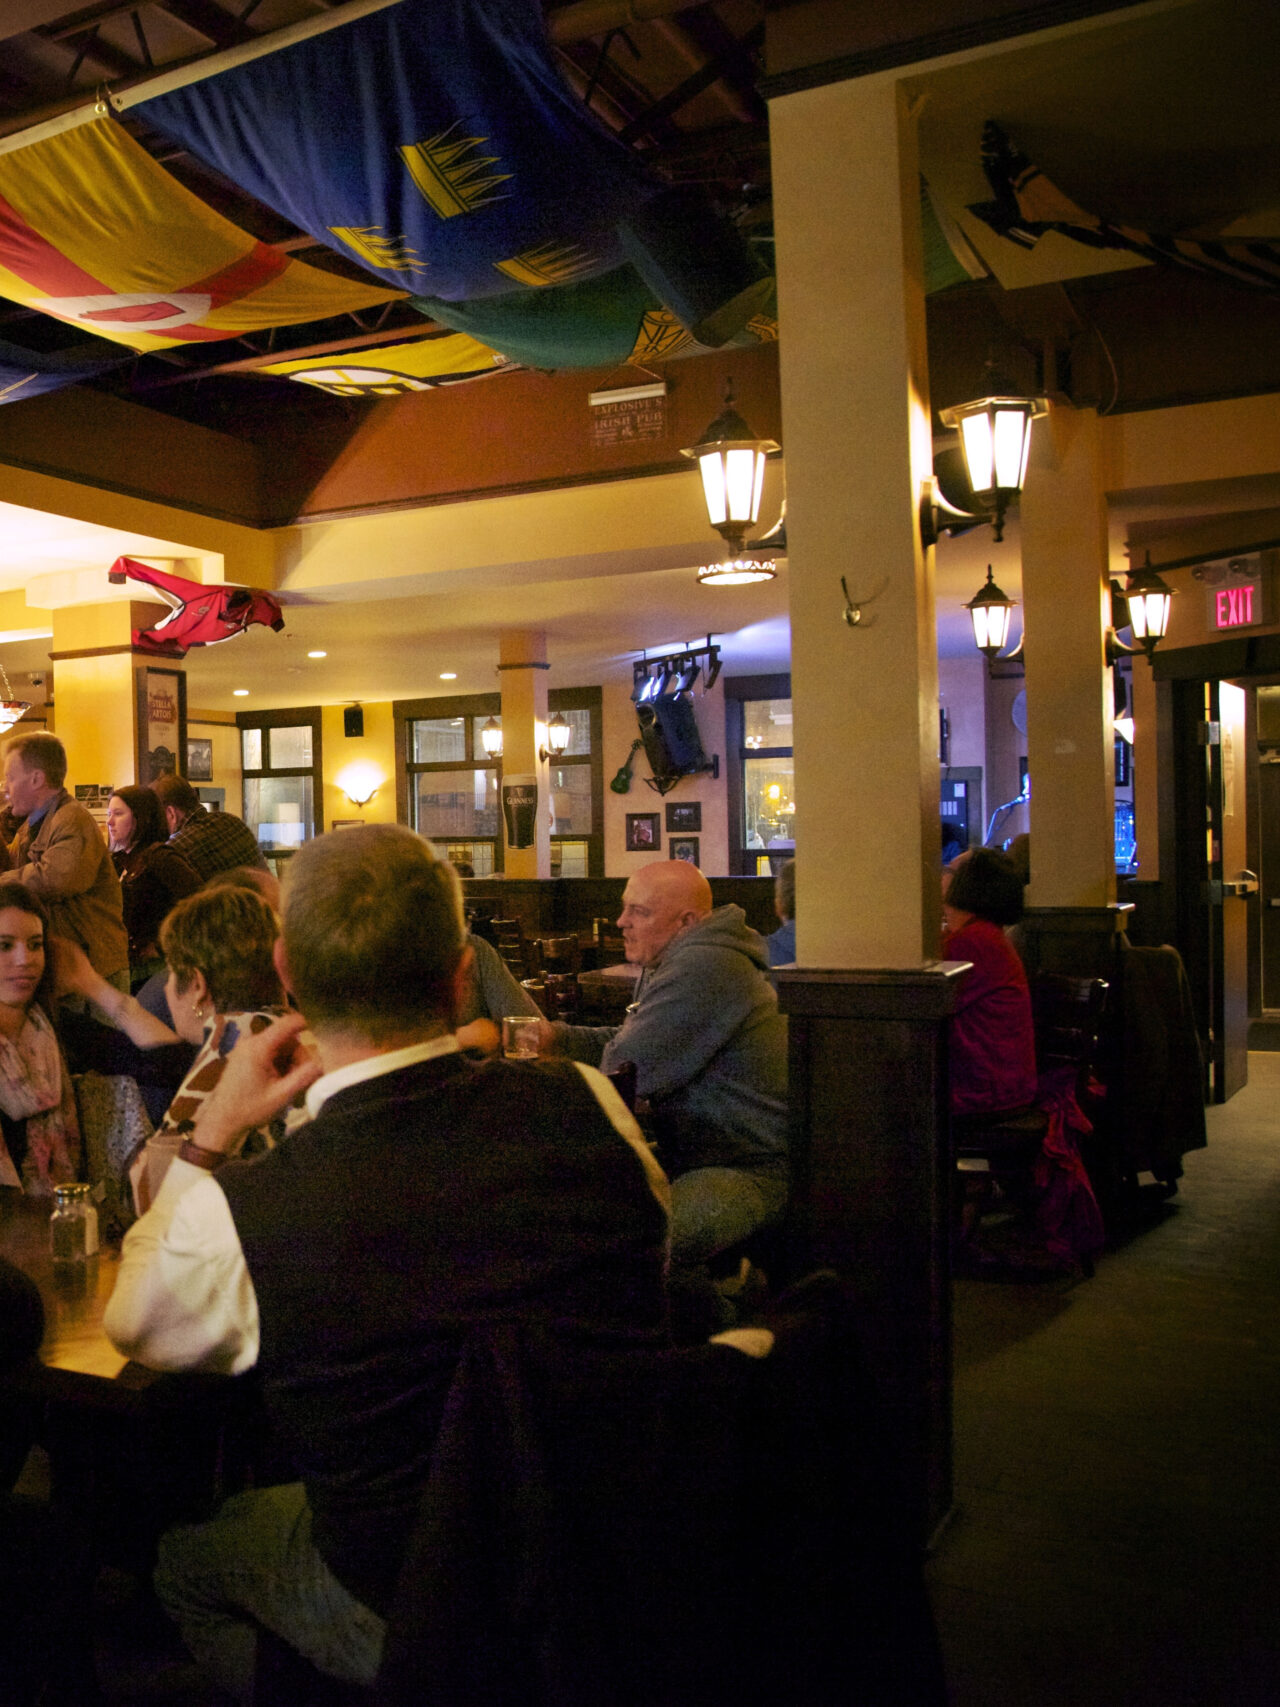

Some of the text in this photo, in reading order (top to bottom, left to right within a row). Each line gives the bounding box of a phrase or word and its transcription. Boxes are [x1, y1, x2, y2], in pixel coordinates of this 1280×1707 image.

[594, 411, 663, 430] IRISH PUB
[1216, 585, 1254, 628] EXIT
[151, 699, 172, 709] STELLA
[151, 709, 172, 721] ARTOIS
[506, 796, 535, 805] GUINNESS
